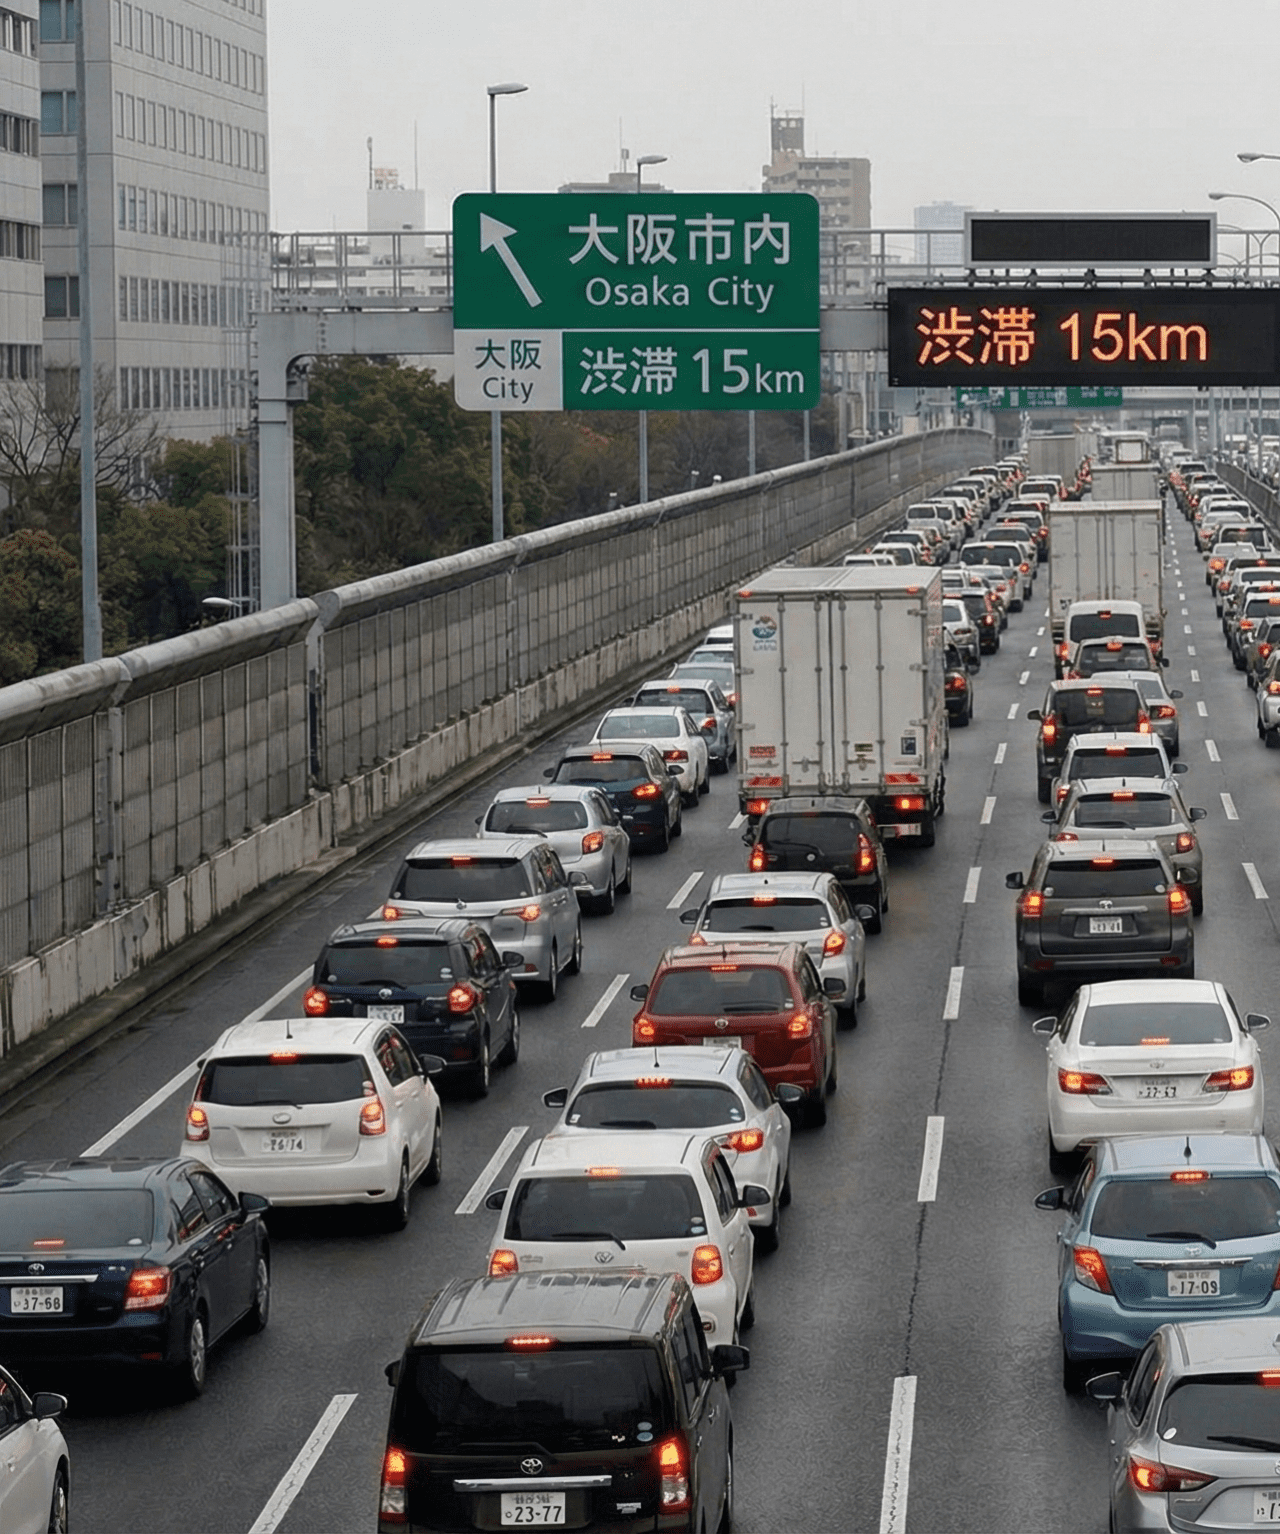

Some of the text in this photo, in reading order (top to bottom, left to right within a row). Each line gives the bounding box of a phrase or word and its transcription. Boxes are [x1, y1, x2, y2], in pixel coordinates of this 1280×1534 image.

[568, 212, 790, 265] 大阪市内
[585, 275, 774, 313] Osaka City
[474, 338, 542, 371] 大阪
[916, 306, 1208, 366] 渋滞 15km
[579, 346, 804, 395] 渋滞 15km
[482, 376, 534, 405] City
[514, 1505, 562, 1523] 23-77
